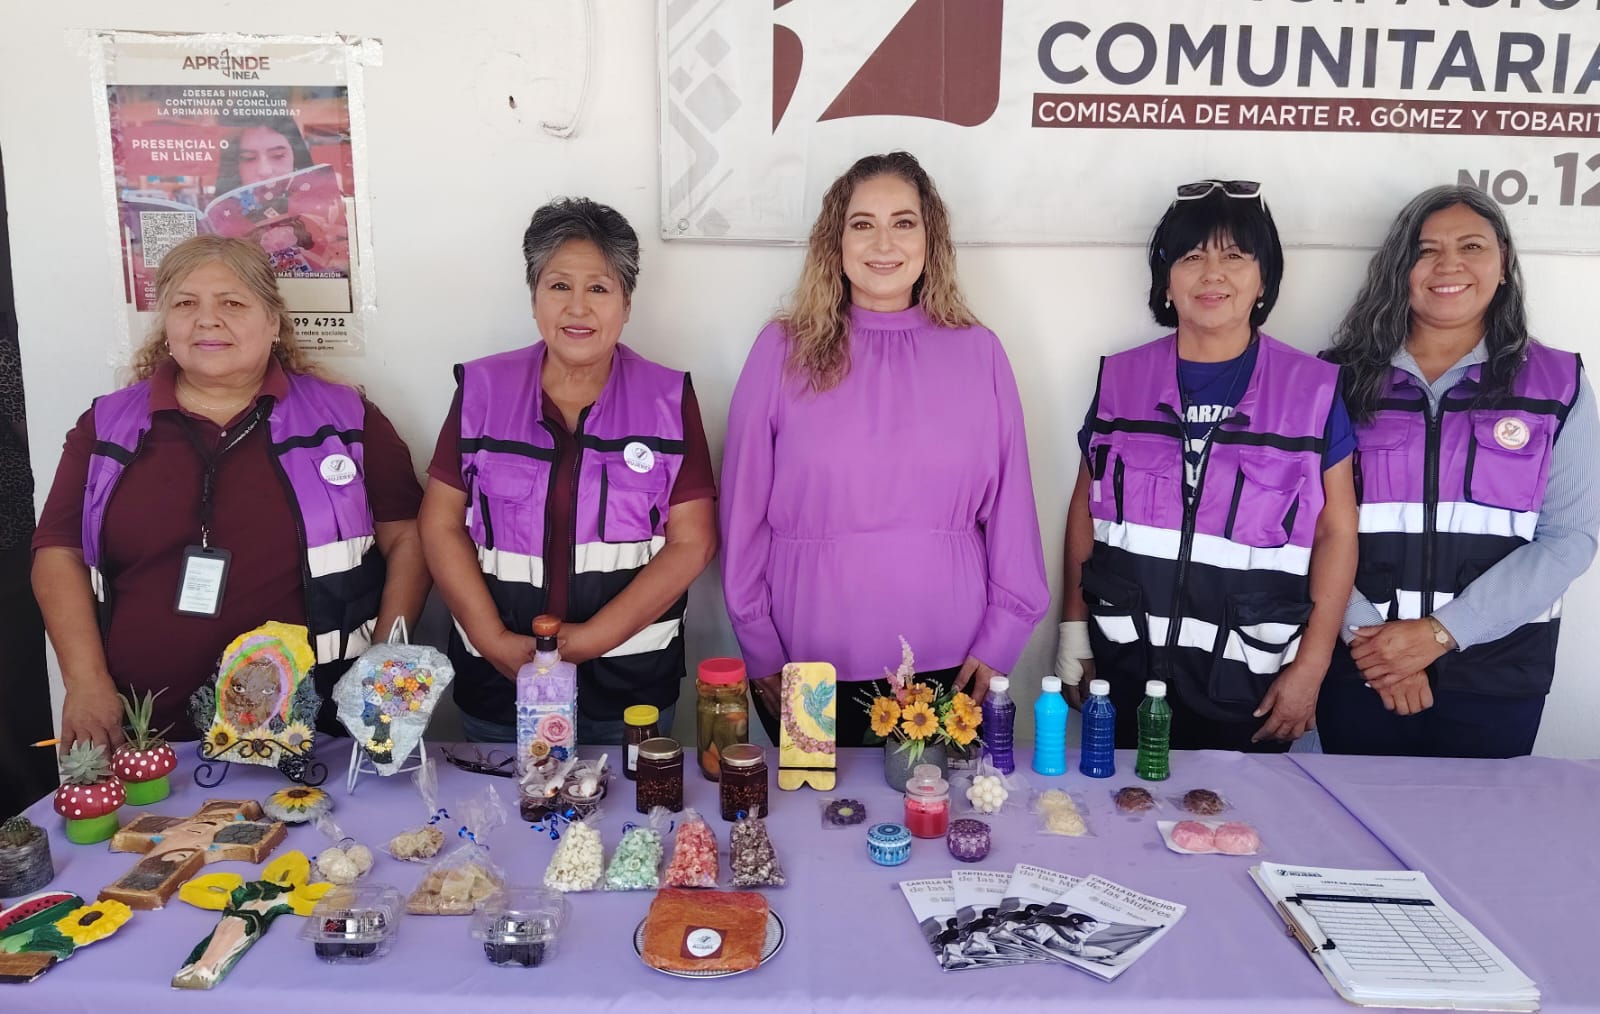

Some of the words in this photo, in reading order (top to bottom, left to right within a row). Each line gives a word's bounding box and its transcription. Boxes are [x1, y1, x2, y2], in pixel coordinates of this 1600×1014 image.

[232, 71, 260, 80] INEA
[182, 89, 225, 98] ¿DESEAS
[228, 89, 269, 98] INICIAR,
[165, 99, 223, 107] CONTINUAR
[226, 99, 234, 107] O
[236, 99, 288, 107] CONCLUIR
[157, 108, 170, 116] LA
[172, 108, 220, 116] PRIMARIA
[222, 108, 230, 116] O
[232, 108, 301, 117] SECUNDARIA?
[1038, 98, 1186, 123] COMISARÍA
[1195, 104, 1231, 125] DE
[1238, 104, 1330, 126] MARTE
[1337, 106, 1361, 127] R.
[1370, 103, 1462, 129] GÓMEZ
[1471, 109, 1489, 129] Y
[132, 139, 216, 149] PRESENCIAL
[219, 139, 230, 149] O
[151, 151, 169, 161] EN
[173, 148, 213, 161] LÍNEA
[314, 317, 345, 327] 4732
[1181, 405, 1234, 422] ARZO
[1092, 877, 1126, 895] CARTILLA
[1138, 896, 1177, 912] DERECHOS
[1103, 888, 1120, 899] las
[1122, 896, 1172, 919] Mujeres
